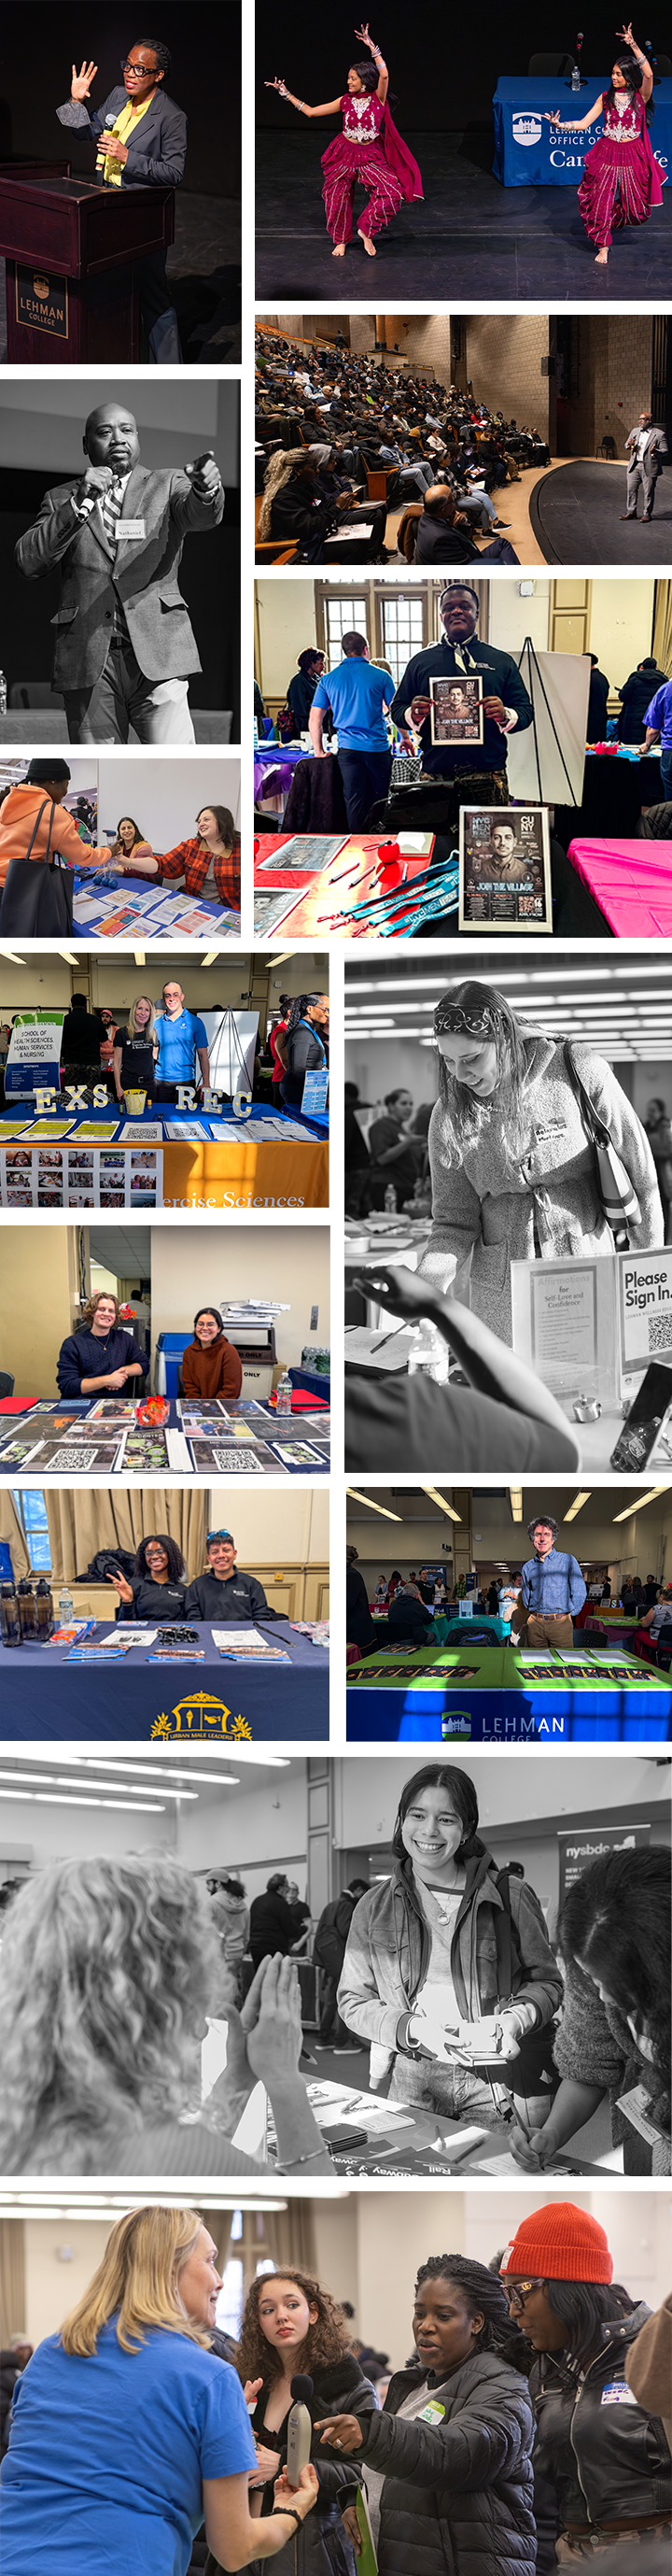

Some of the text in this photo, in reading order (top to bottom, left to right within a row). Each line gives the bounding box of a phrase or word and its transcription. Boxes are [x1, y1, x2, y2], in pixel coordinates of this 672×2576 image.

[549, 136, 584, 145] OFFICE
[21, 297, 63, 320] LEHMAN
[29, 312, 55, 327] COLLEGE
[520, 815, 535, 824] CU
[521, 823, 535, 831] NY
[476, 883, 493, 891] JOIN
[506, 883, 535, 892] VILLAGE
[162, 1192, 305, 1208] ercise Sciences
[538, 1275, 590, 1286] Affirmations
[625, 1271, 667, 1289] Please
[548, 1300, 581, 1309] Confidence
[625, 1289, 655, 1309] Sign
[483, 1718, 565, 1733] LEHMAN
